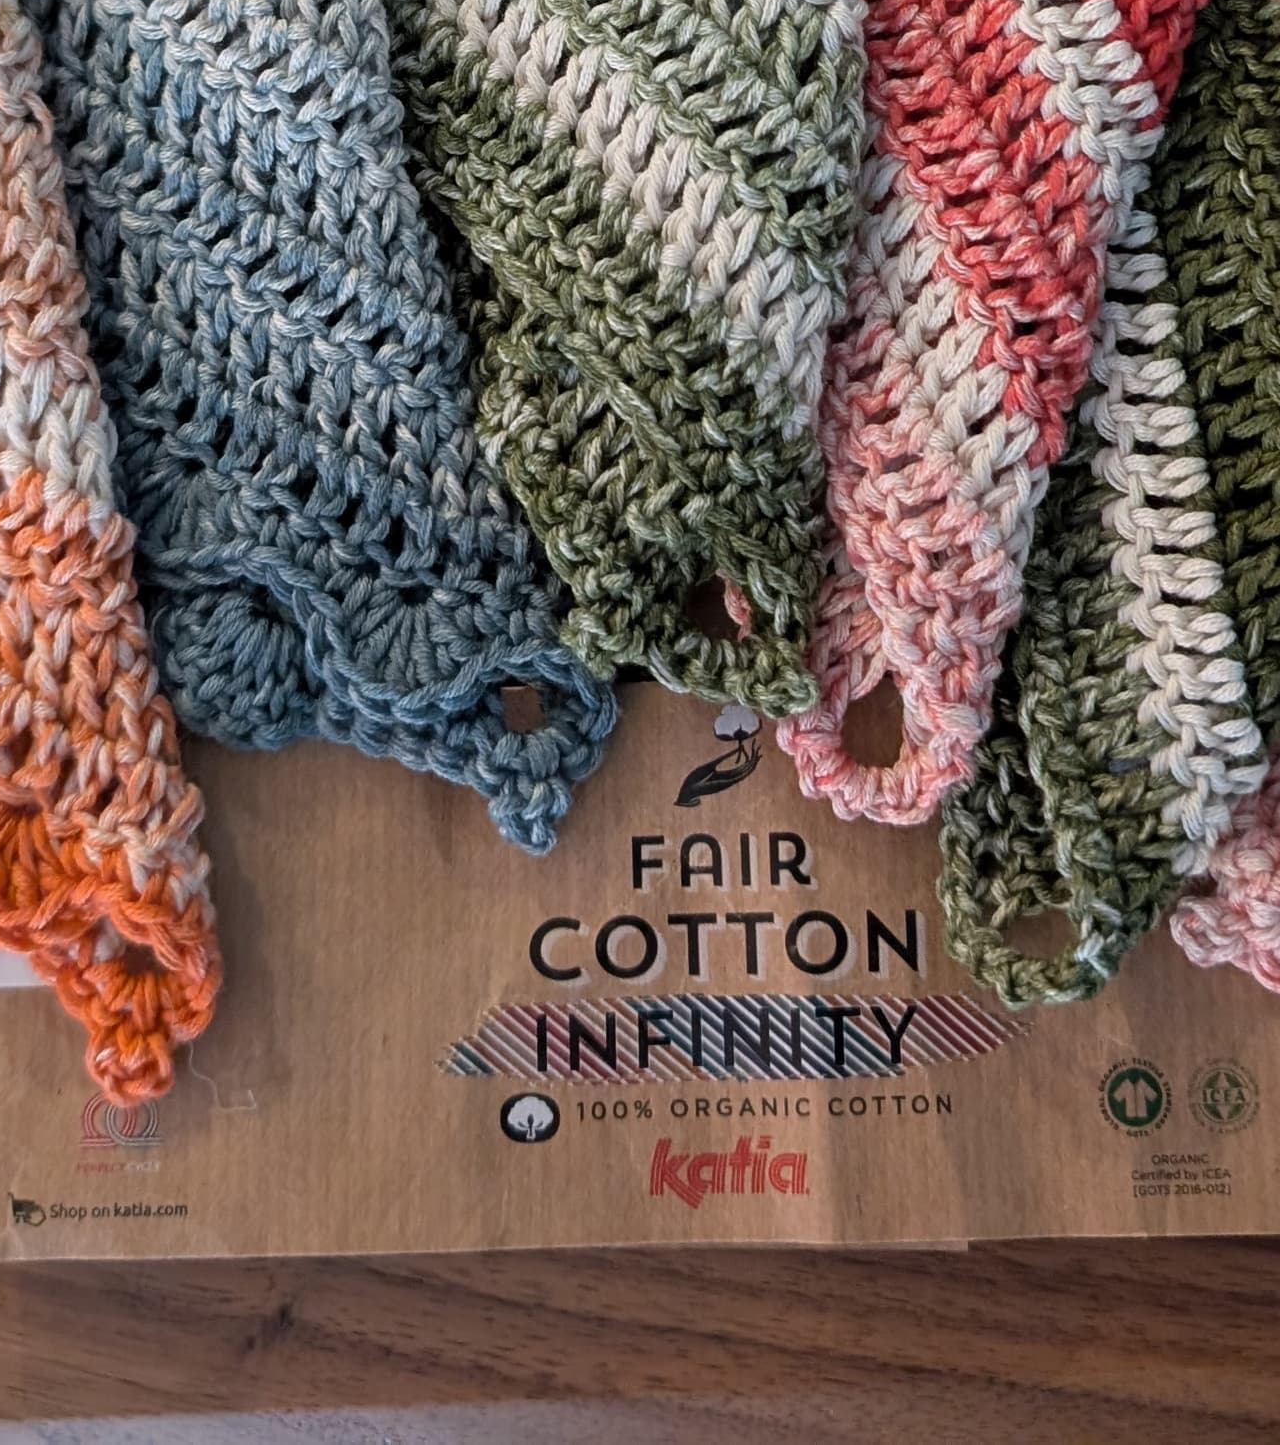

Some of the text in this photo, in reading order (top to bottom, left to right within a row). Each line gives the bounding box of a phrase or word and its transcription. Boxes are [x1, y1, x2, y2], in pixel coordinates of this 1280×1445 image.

[630, 831, 814, 891] FAIR
[528, 909, 924, 984] COTTON
[535, 1005, 919, 1073] INFINITY
[577, 1093, 954, 1123] 100% ORGANIC COTTON
[1201, 1088, 1247, 1106] ICEA
[649, 1134, 811, 1210] katia
[1131, 1168, 1232, 1182] Certified by ICEA
[1151, 1154, 1210, 1166] ORGANIC
[49, 1202, 189, 1222] Shop on katia.com
